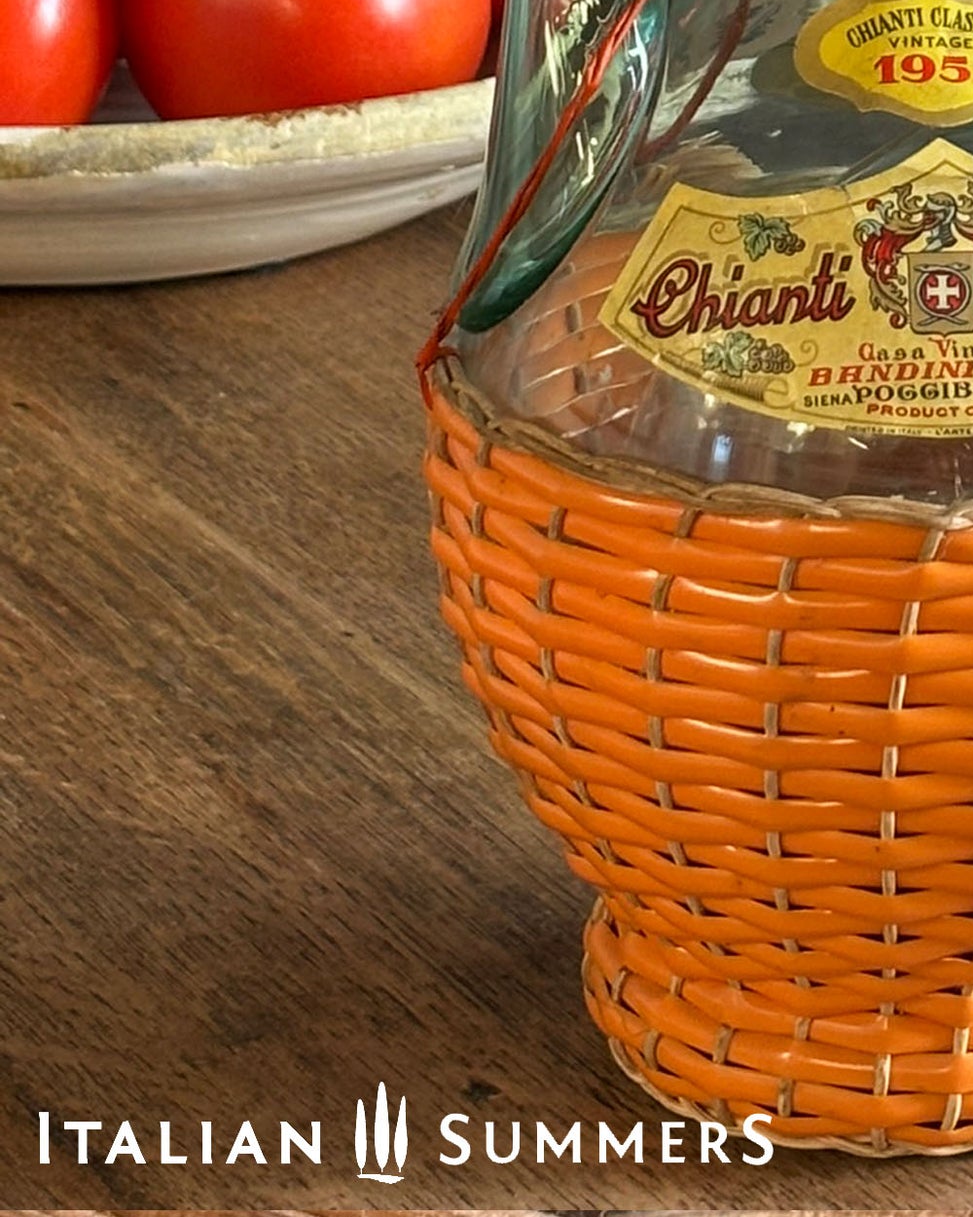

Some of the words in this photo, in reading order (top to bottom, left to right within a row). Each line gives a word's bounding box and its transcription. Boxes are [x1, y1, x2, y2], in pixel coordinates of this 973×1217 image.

[846, 7, 924, 49] CHIANTI
[888, 35, 973, 50] VINTAGE
[630, 251, 857, 339] Chianti
[858, 342, 925, 362] Casa
[803, 393, 853, 408] SIENA
[866, 403, 959, 418] PRODUCT
